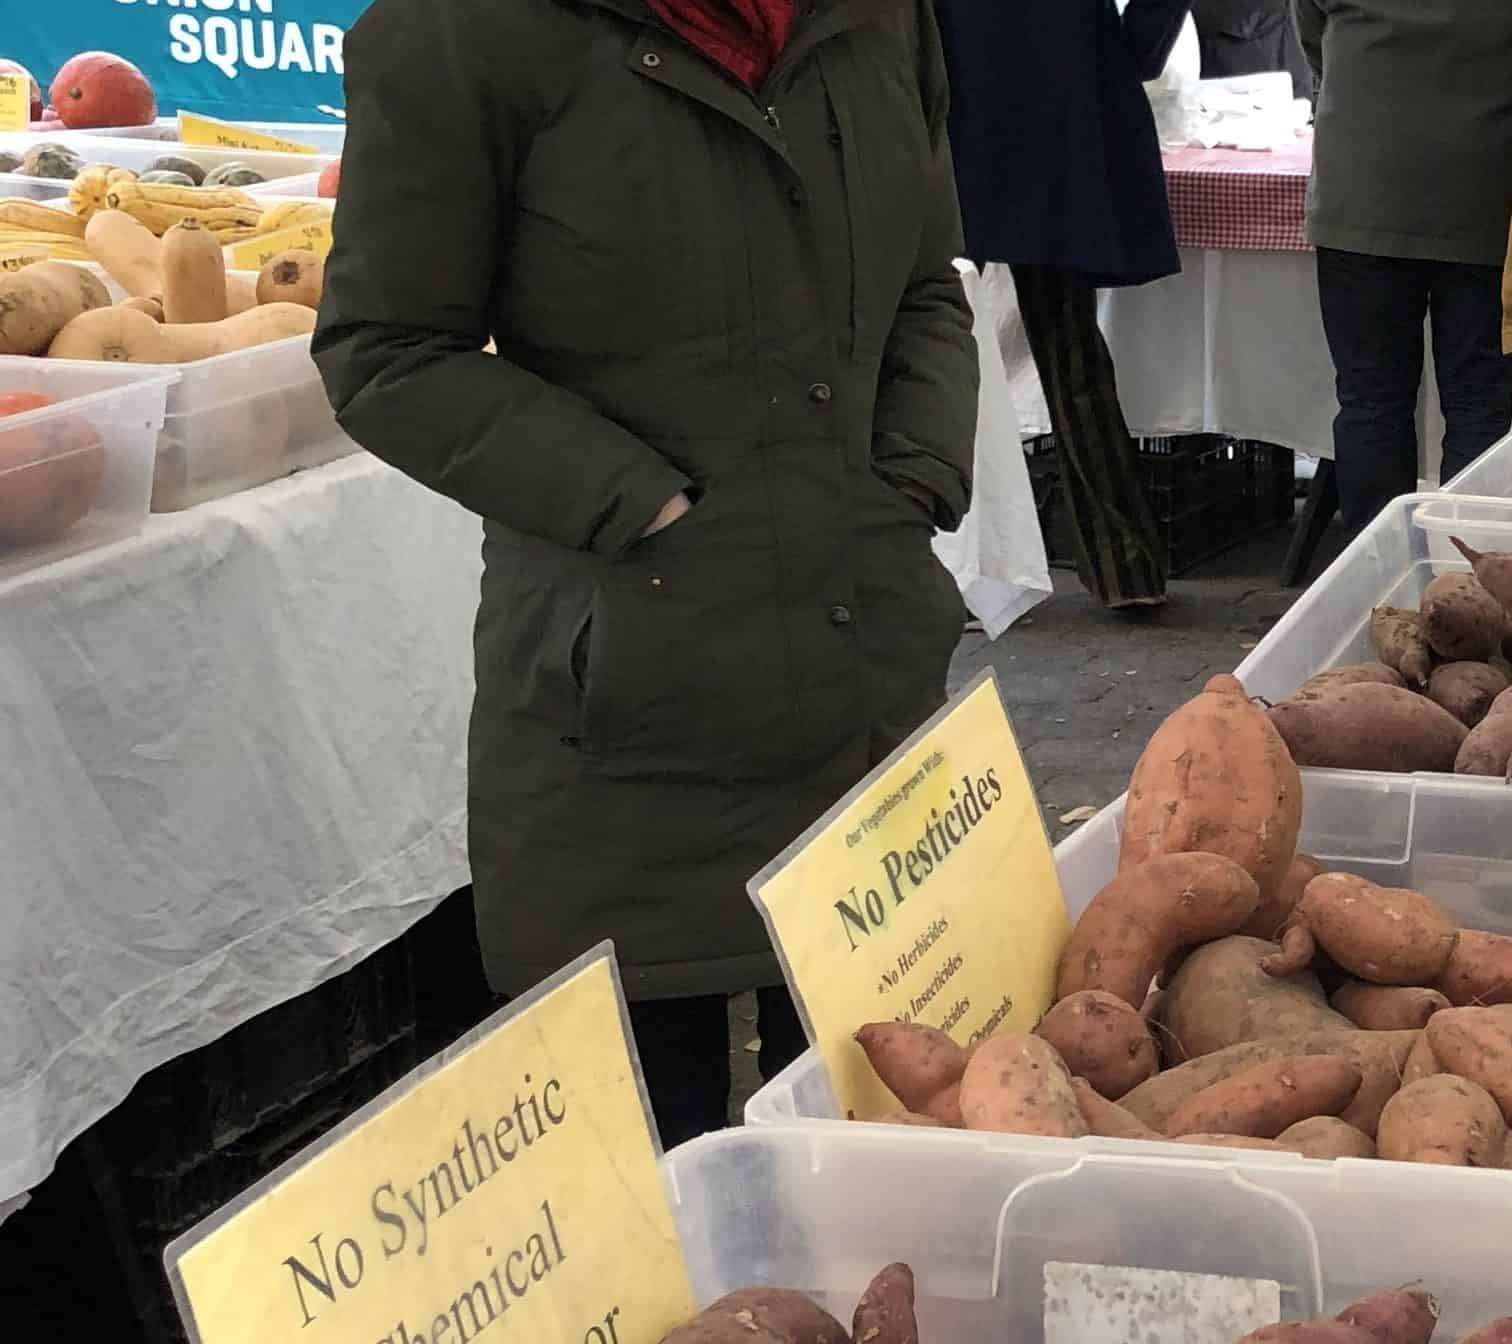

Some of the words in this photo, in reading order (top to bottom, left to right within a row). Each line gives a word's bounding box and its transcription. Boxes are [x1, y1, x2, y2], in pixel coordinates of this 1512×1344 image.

[170, 13, 345, 79] SQUAR
[833, 885, 884, 953] No
[880, 765, 1004, 907] Pesticides
[896, 916, 950, 982] Herbicides
[908, 952, 964, 1022] Insecticides
[281, 1230, 365, 1328] No
[371, 1072, 568, 1258] Synthetic
